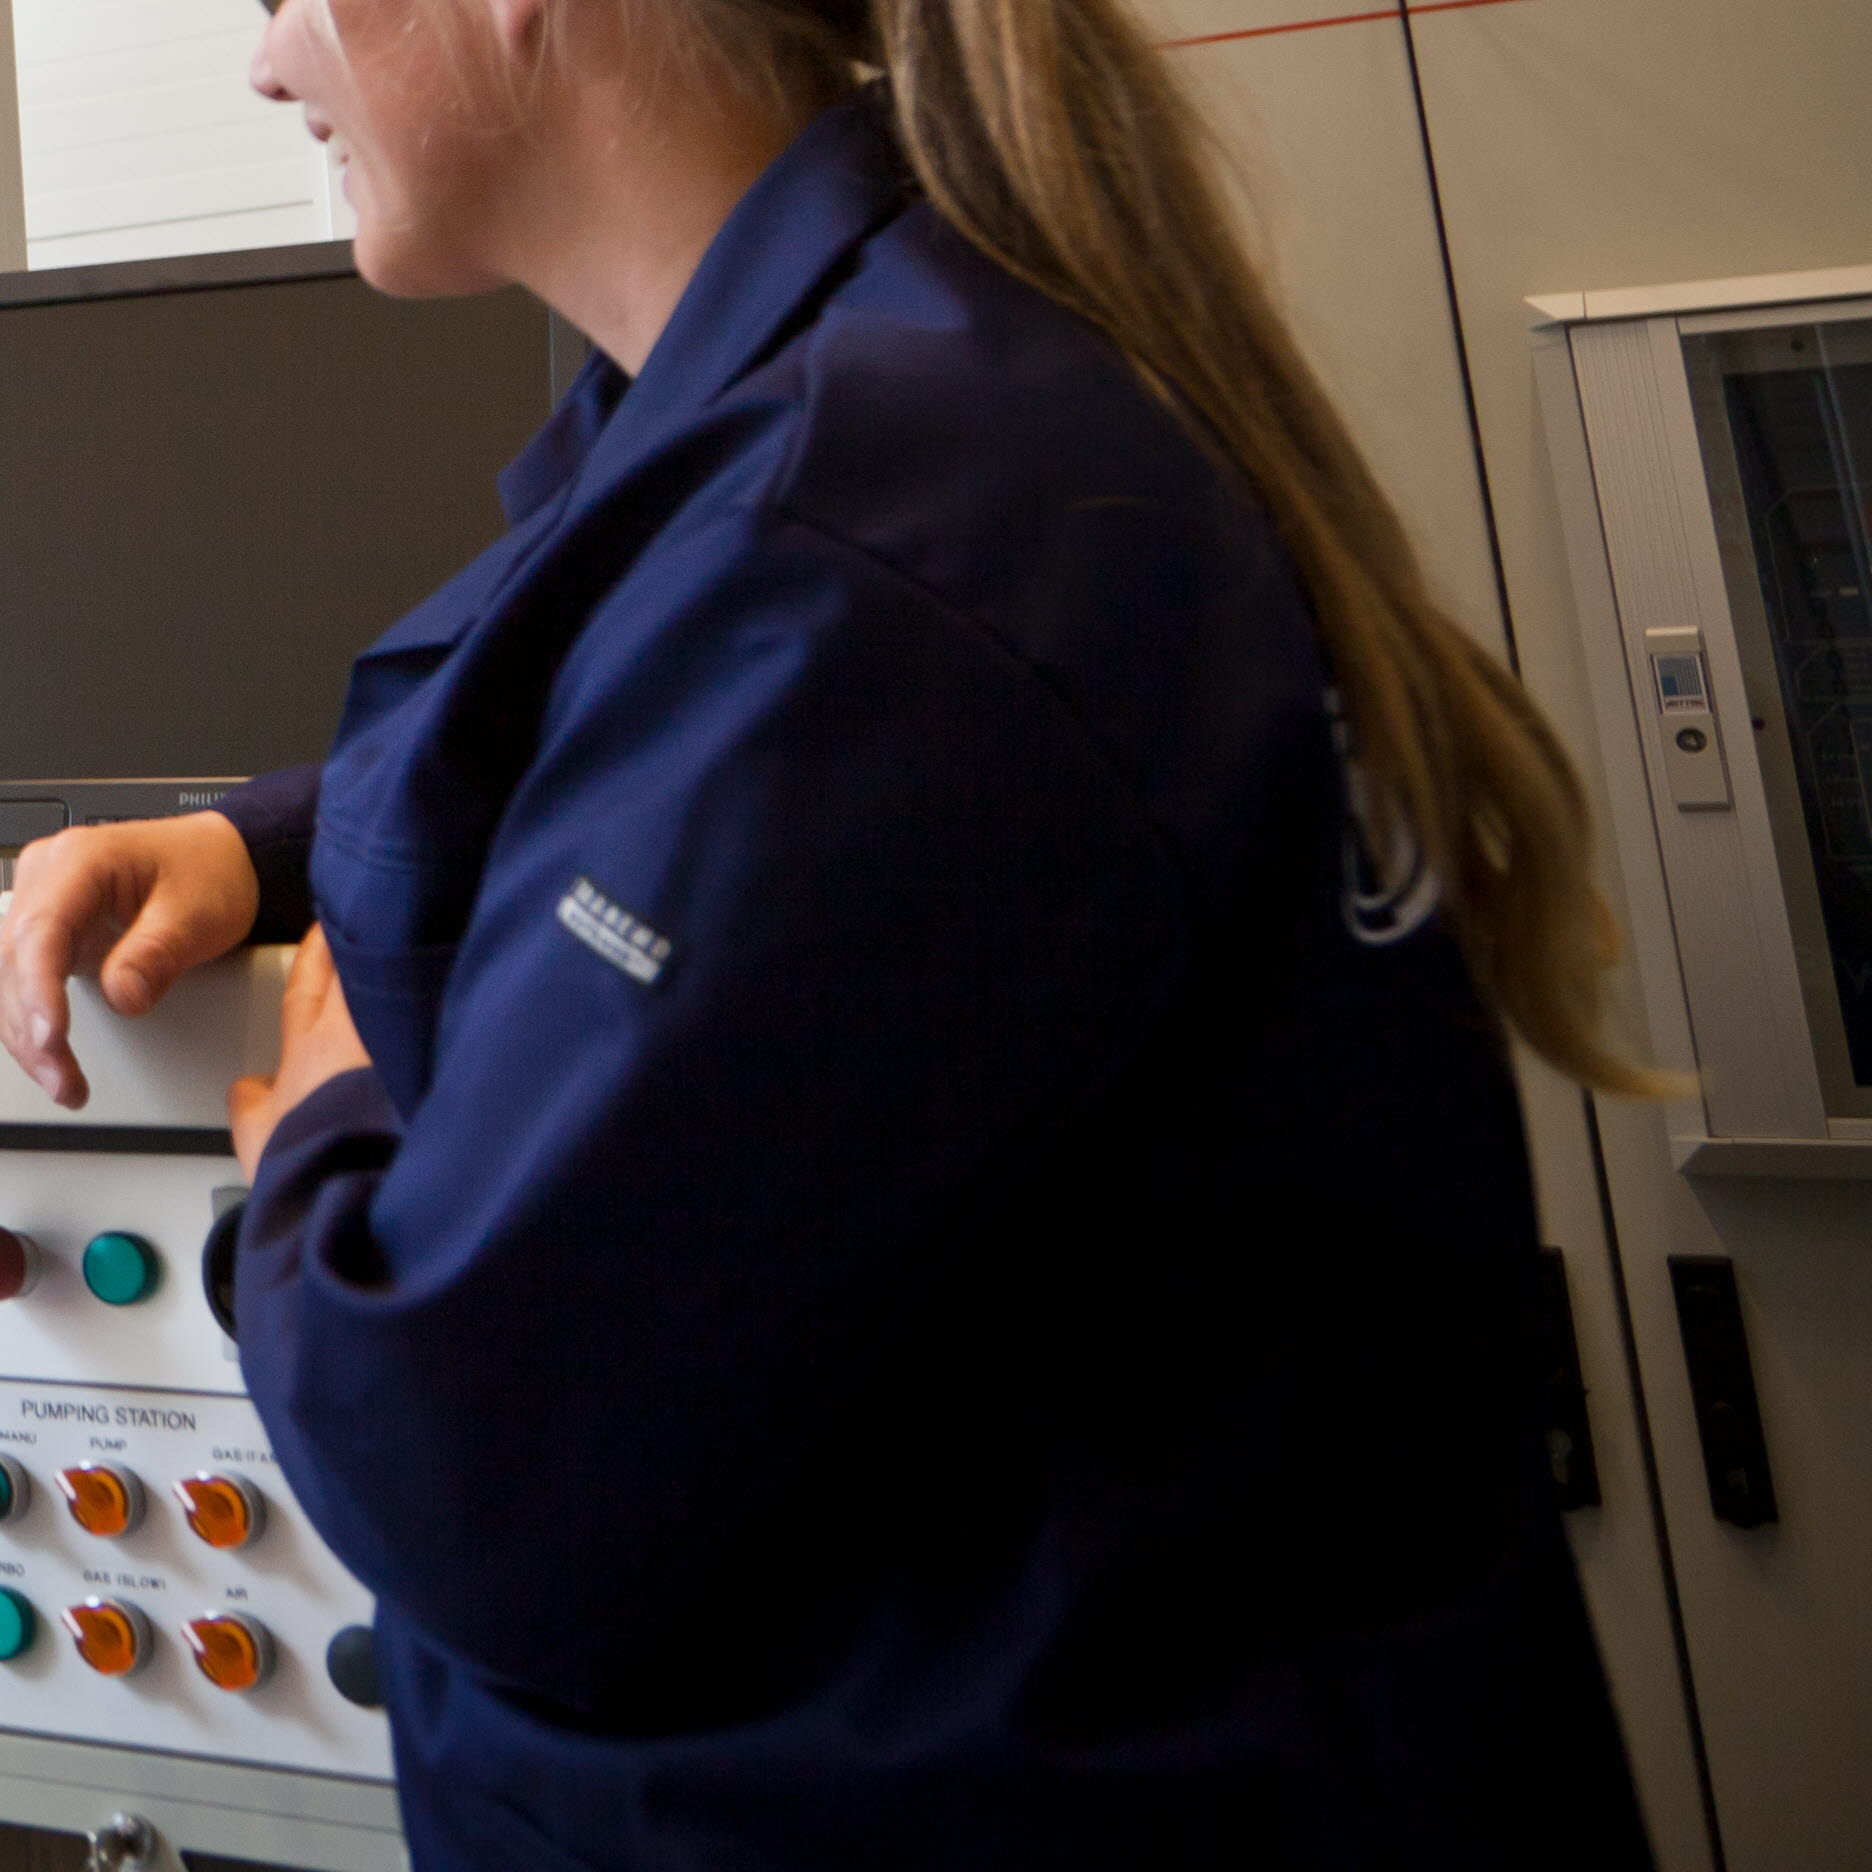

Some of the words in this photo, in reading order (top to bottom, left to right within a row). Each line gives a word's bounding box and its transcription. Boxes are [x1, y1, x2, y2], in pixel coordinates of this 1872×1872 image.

[179, 791, 226, 806] PHILI
[20, 1399, 110, 1425] PUMPING
[114, 1407, 198, 1432] STATION
[89, 1437, 127, 1451] PUMP
[212, 1447, 243, 1462] GAS
[82, 1569, 112, 1585] GAS
[225, 1587, 249, 1601] AIR
